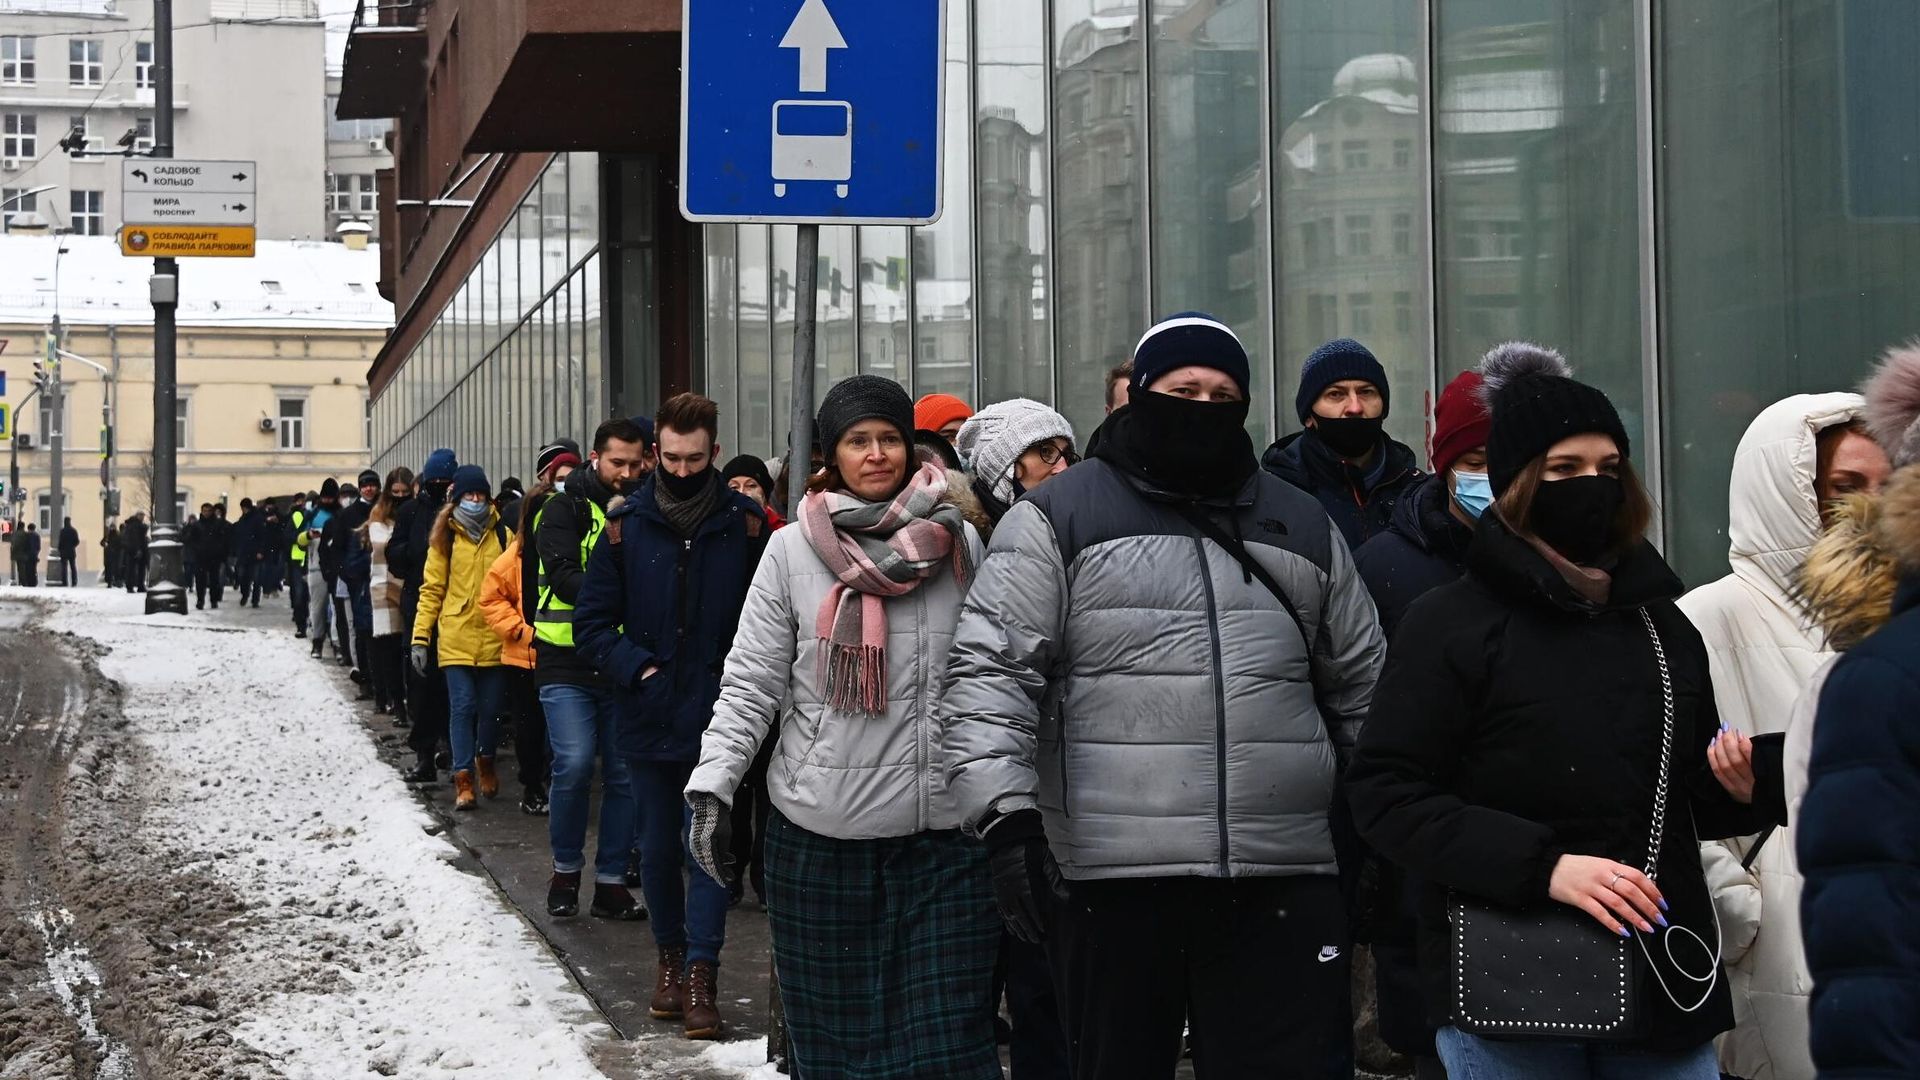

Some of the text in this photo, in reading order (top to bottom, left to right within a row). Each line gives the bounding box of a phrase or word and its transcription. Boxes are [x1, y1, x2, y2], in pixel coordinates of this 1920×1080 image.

[153, 166, 202, 175] САДОВОЕ
[153, 178, 194, 186] КОЛЬЦО
[153, 198, 180, 206] МИРА
[153, 209, 196, 217] проспект
[152, 231, 219, 241] СОБЛЮДАЙТЕ
[1321, 945, 1338, 955] NIKE
